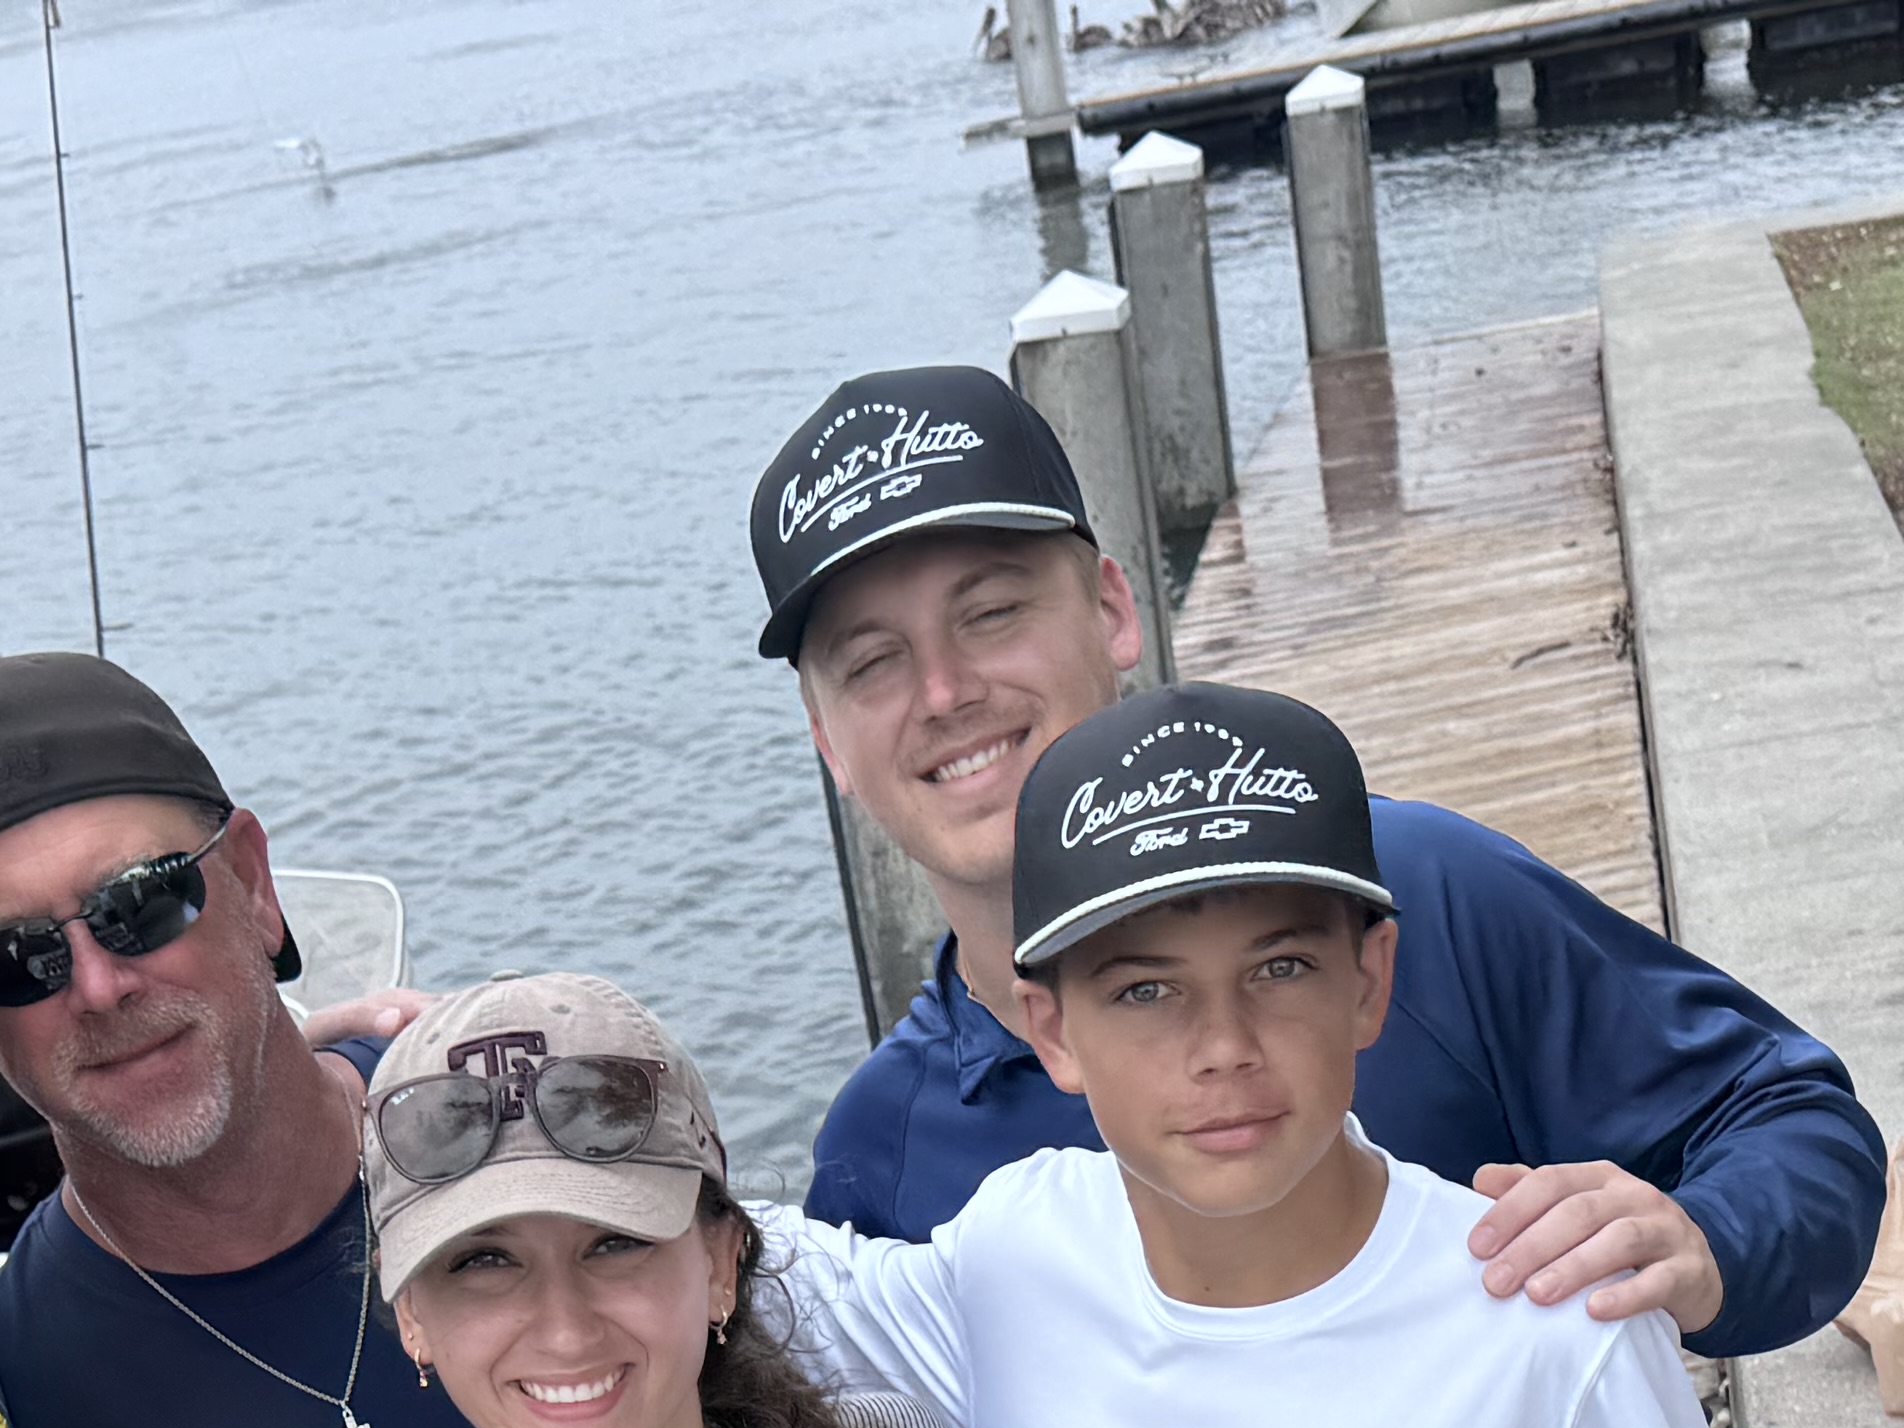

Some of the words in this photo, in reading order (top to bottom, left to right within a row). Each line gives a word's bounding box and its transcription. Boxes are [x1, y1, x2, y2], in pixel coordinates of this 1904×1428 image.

[779, 445, 868, 543] Covert
[881, 410, 984, 468] Hutto
[1061, 768, 1193, 849] Covert
[1209, 748, 1318, 805] Hutto
[1129, 827, 1188, 857] Ford
